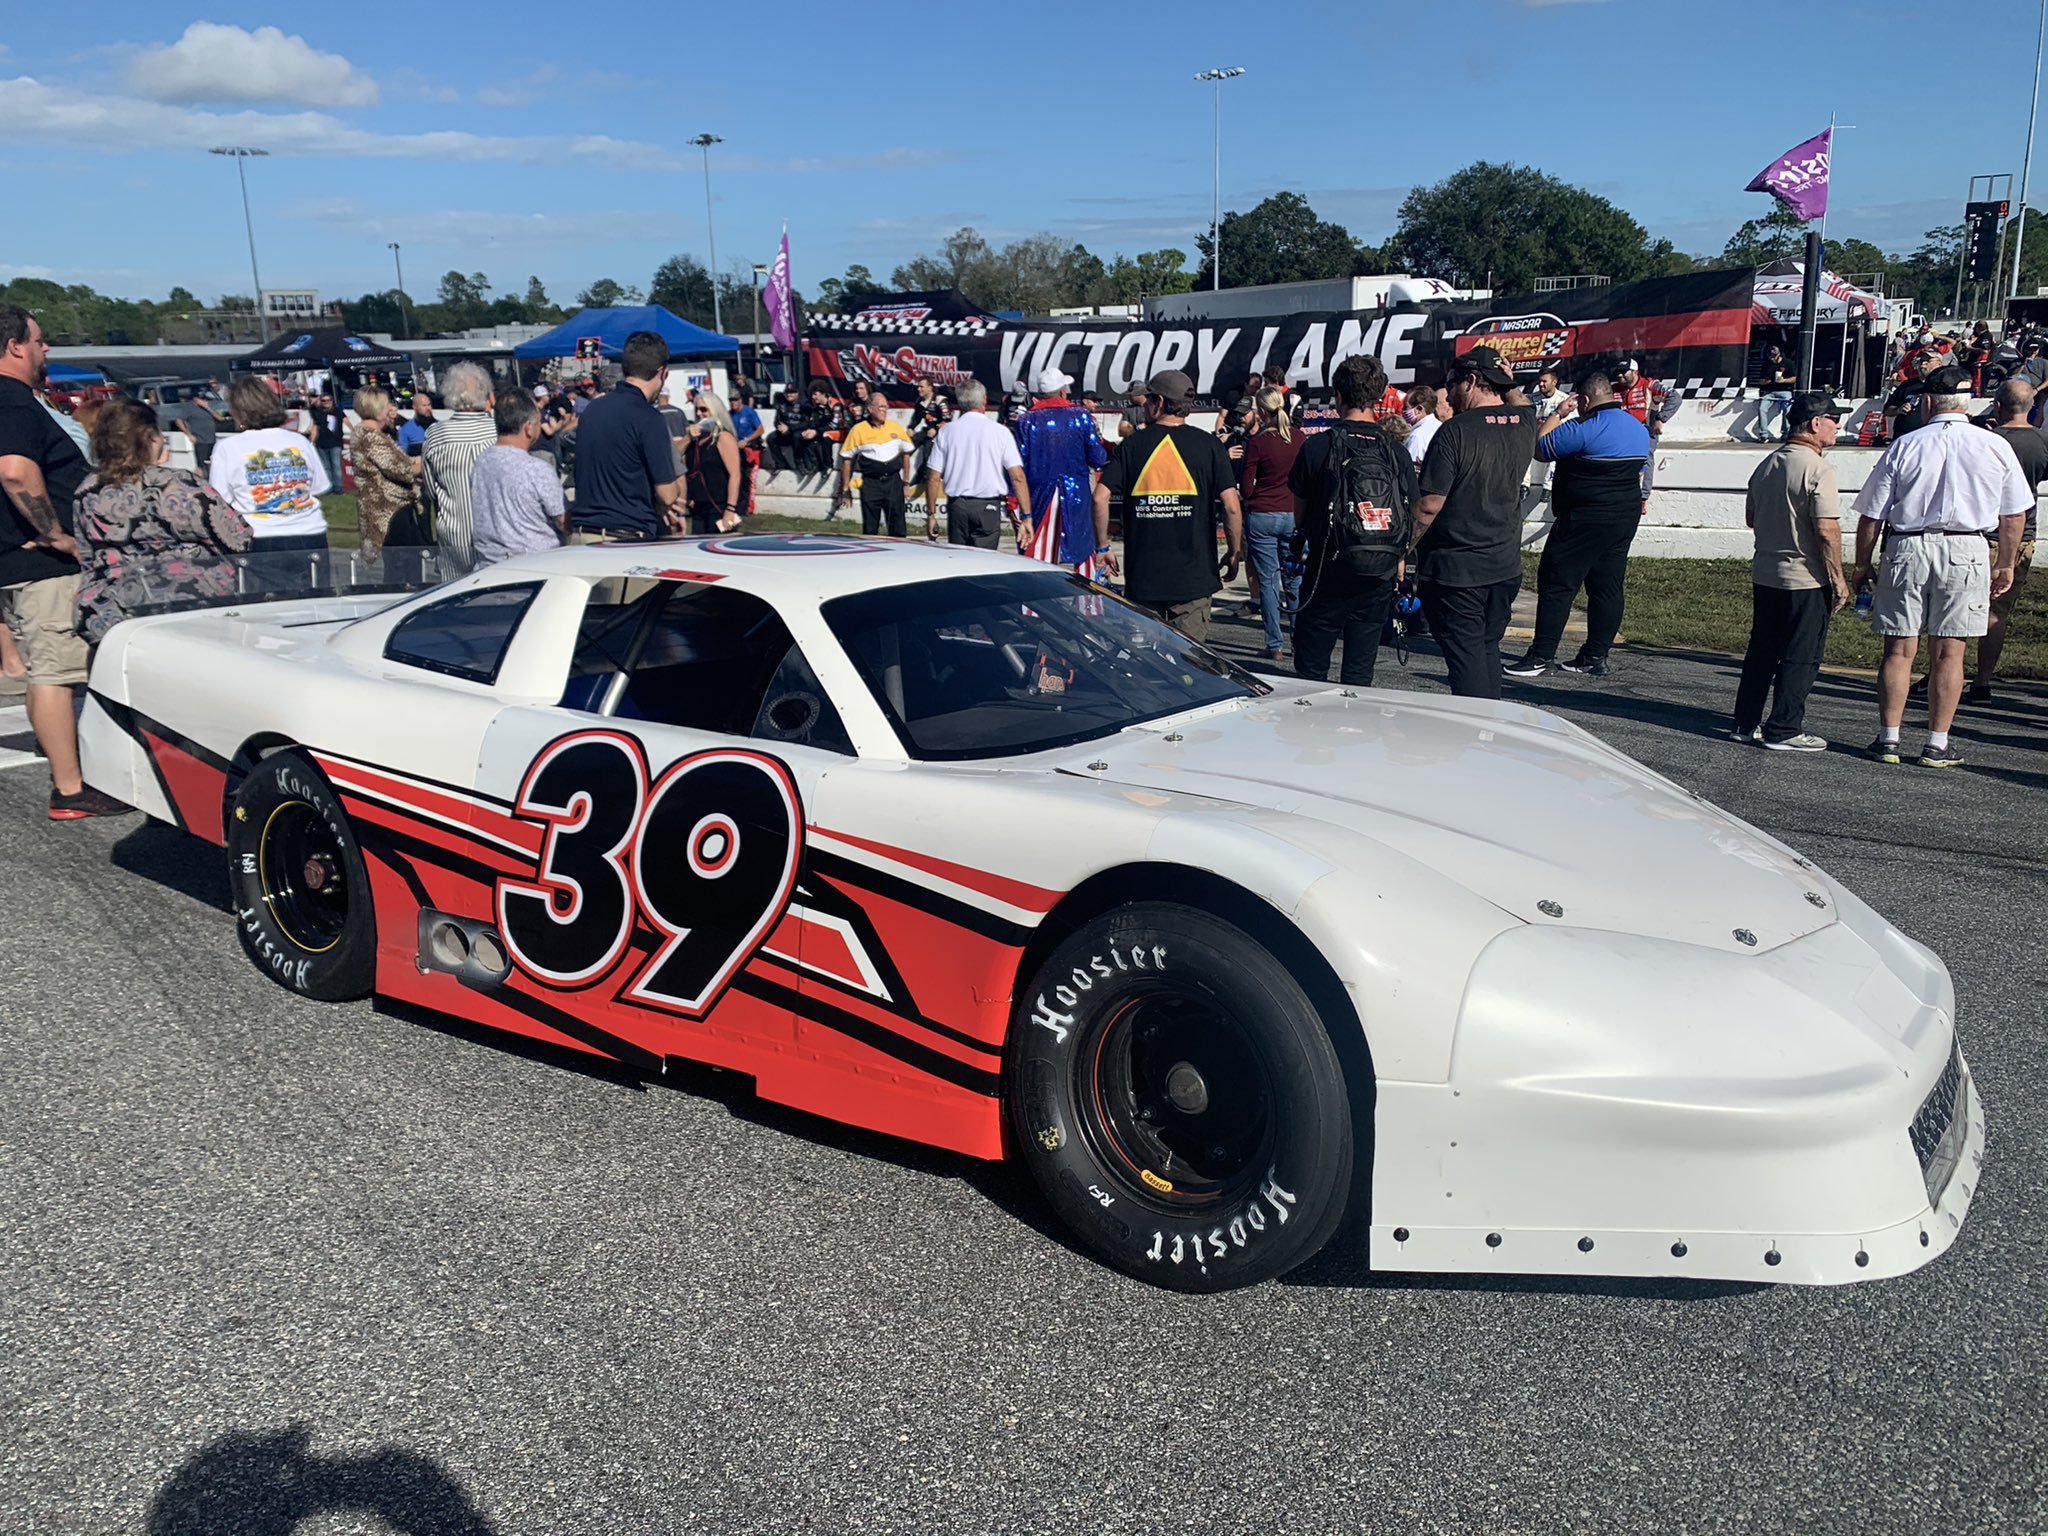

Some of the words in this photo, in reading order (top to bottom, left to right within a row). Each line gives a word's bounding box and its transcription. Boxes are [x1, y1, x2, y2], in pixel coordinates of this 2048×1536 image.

[1501, 317, 1542, 331] NASCAR
[1780, 307, 1838, 319] FACORY
[1471, 332, 1540, 350] Advance
[895, 346, 957, 384] SMYRNA
[1516, 359, 1543, 370] SERIES
[1147, 495, 1180, 505] BODE
[275, 767, 346, 848] Hoosier
[492, 728, 807, 1022] 39
[240, 907, 316, 990] Hoosier
[1031, 936, 1168, 1044] Hoosier
[1144, 1172, 1171, 1191] Bassett
[1145, 1162, 1297, 1276] Hoosier
